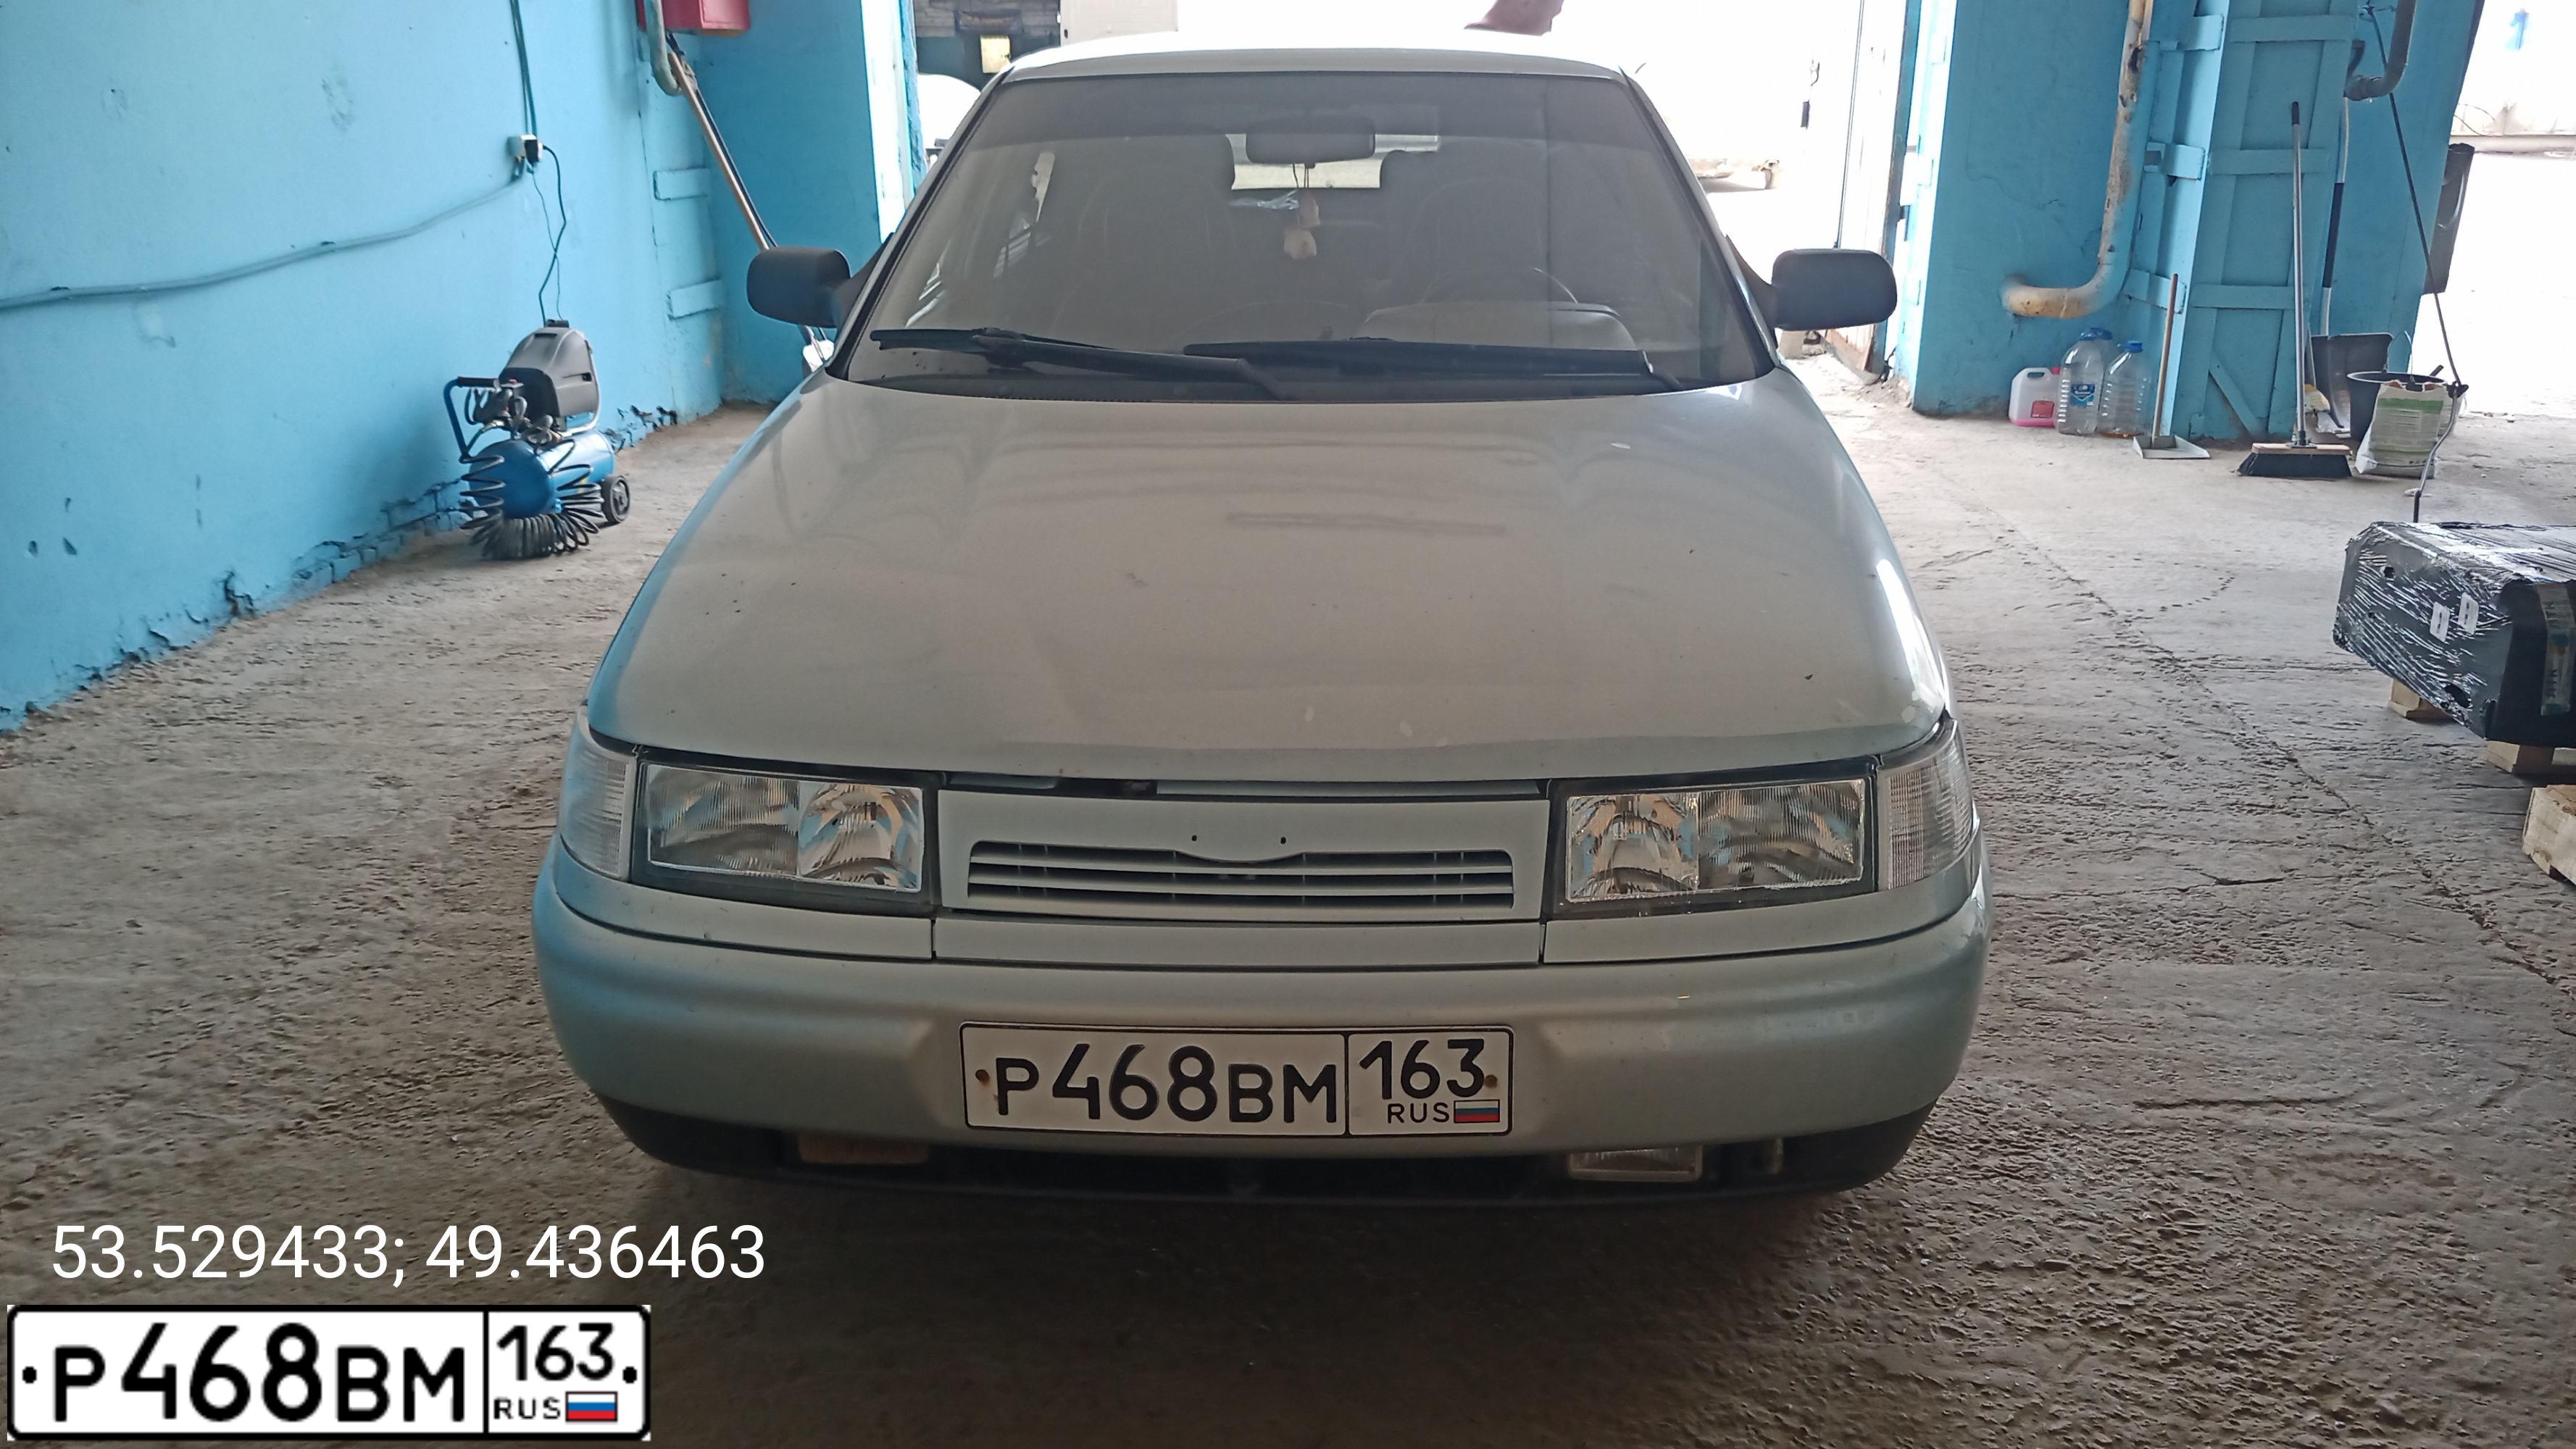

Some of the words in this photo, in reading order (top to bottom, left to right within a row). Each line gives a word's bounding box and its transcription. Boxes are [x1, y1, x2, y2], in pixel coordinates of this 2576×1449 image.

[993, 1043, 1337, 1124] Р468ВМ
[1359, 1038, 1485, 1101] 163
[1387, 1102, 1450, 1124] RUS
